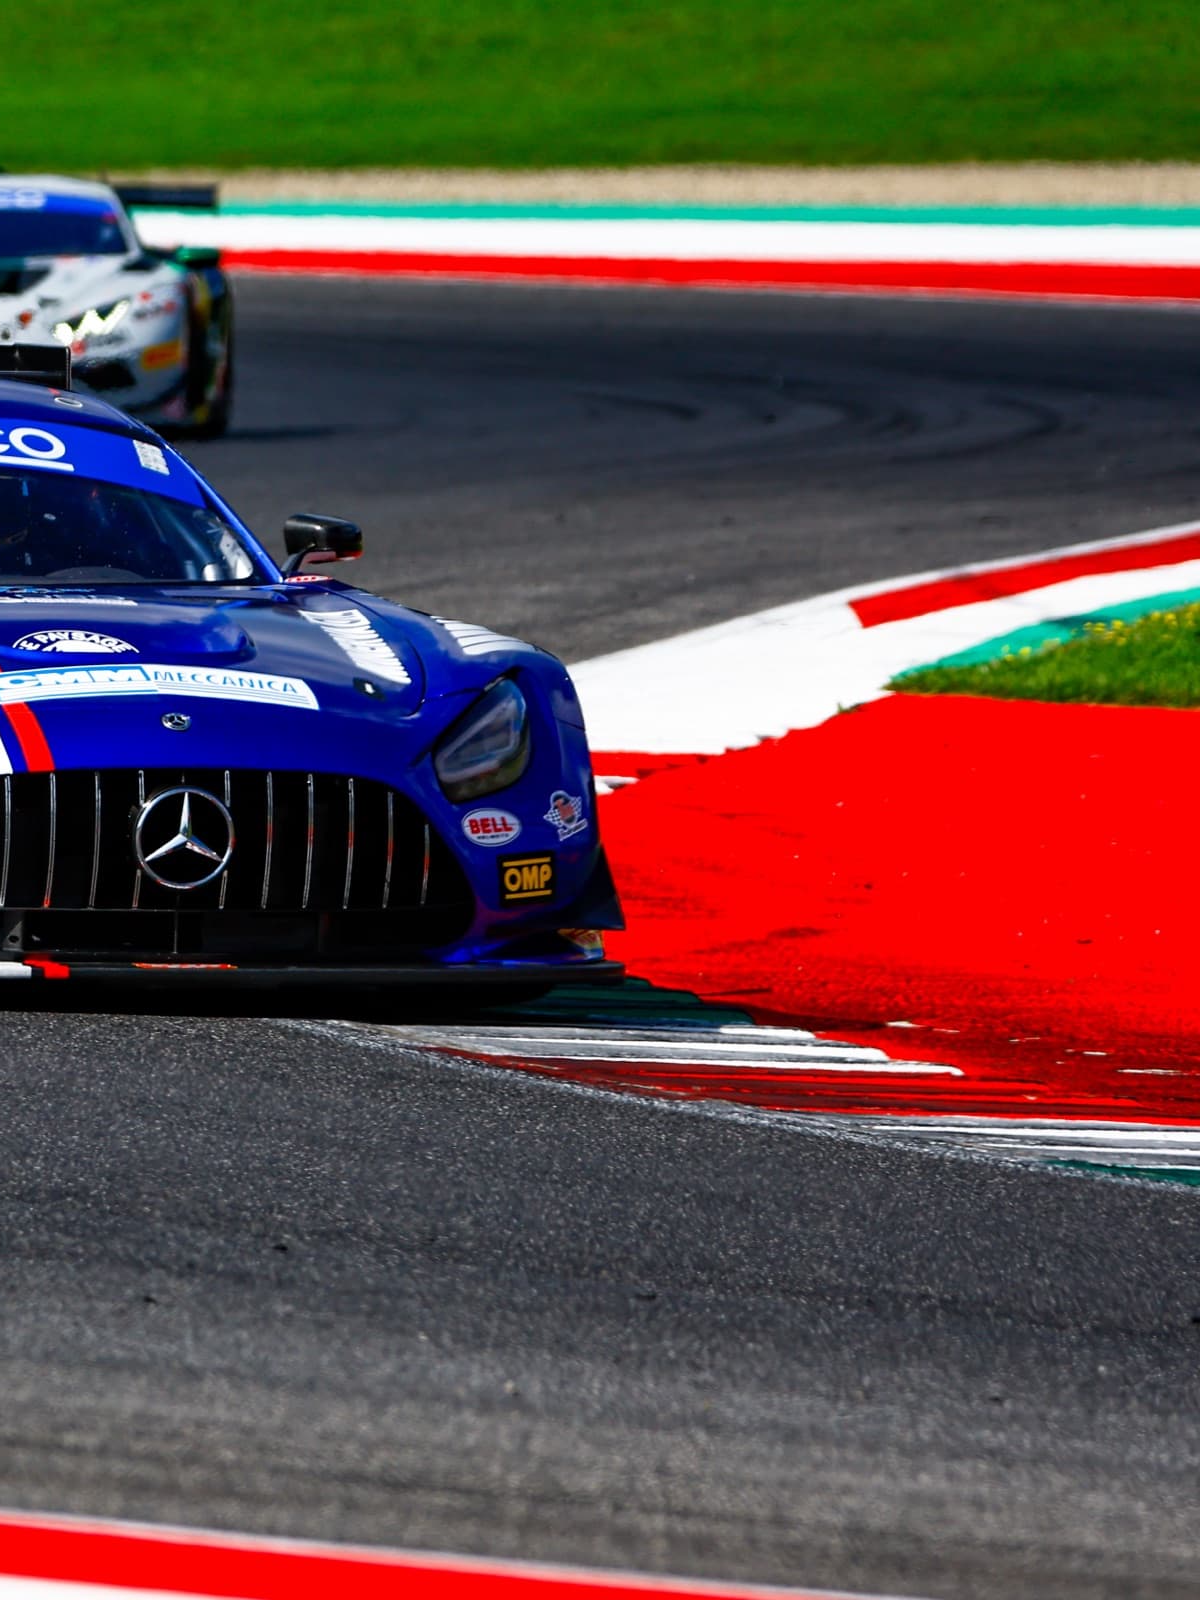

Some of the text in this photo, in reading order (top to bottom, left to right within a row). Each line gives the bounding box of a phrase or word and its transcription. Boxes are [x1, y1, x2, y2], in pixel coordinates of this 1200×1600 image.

[154, 670, 297, 694] MECCANICA
[468, 816, 513, 835] BELL
[504, 864, 553, 892] OMP
